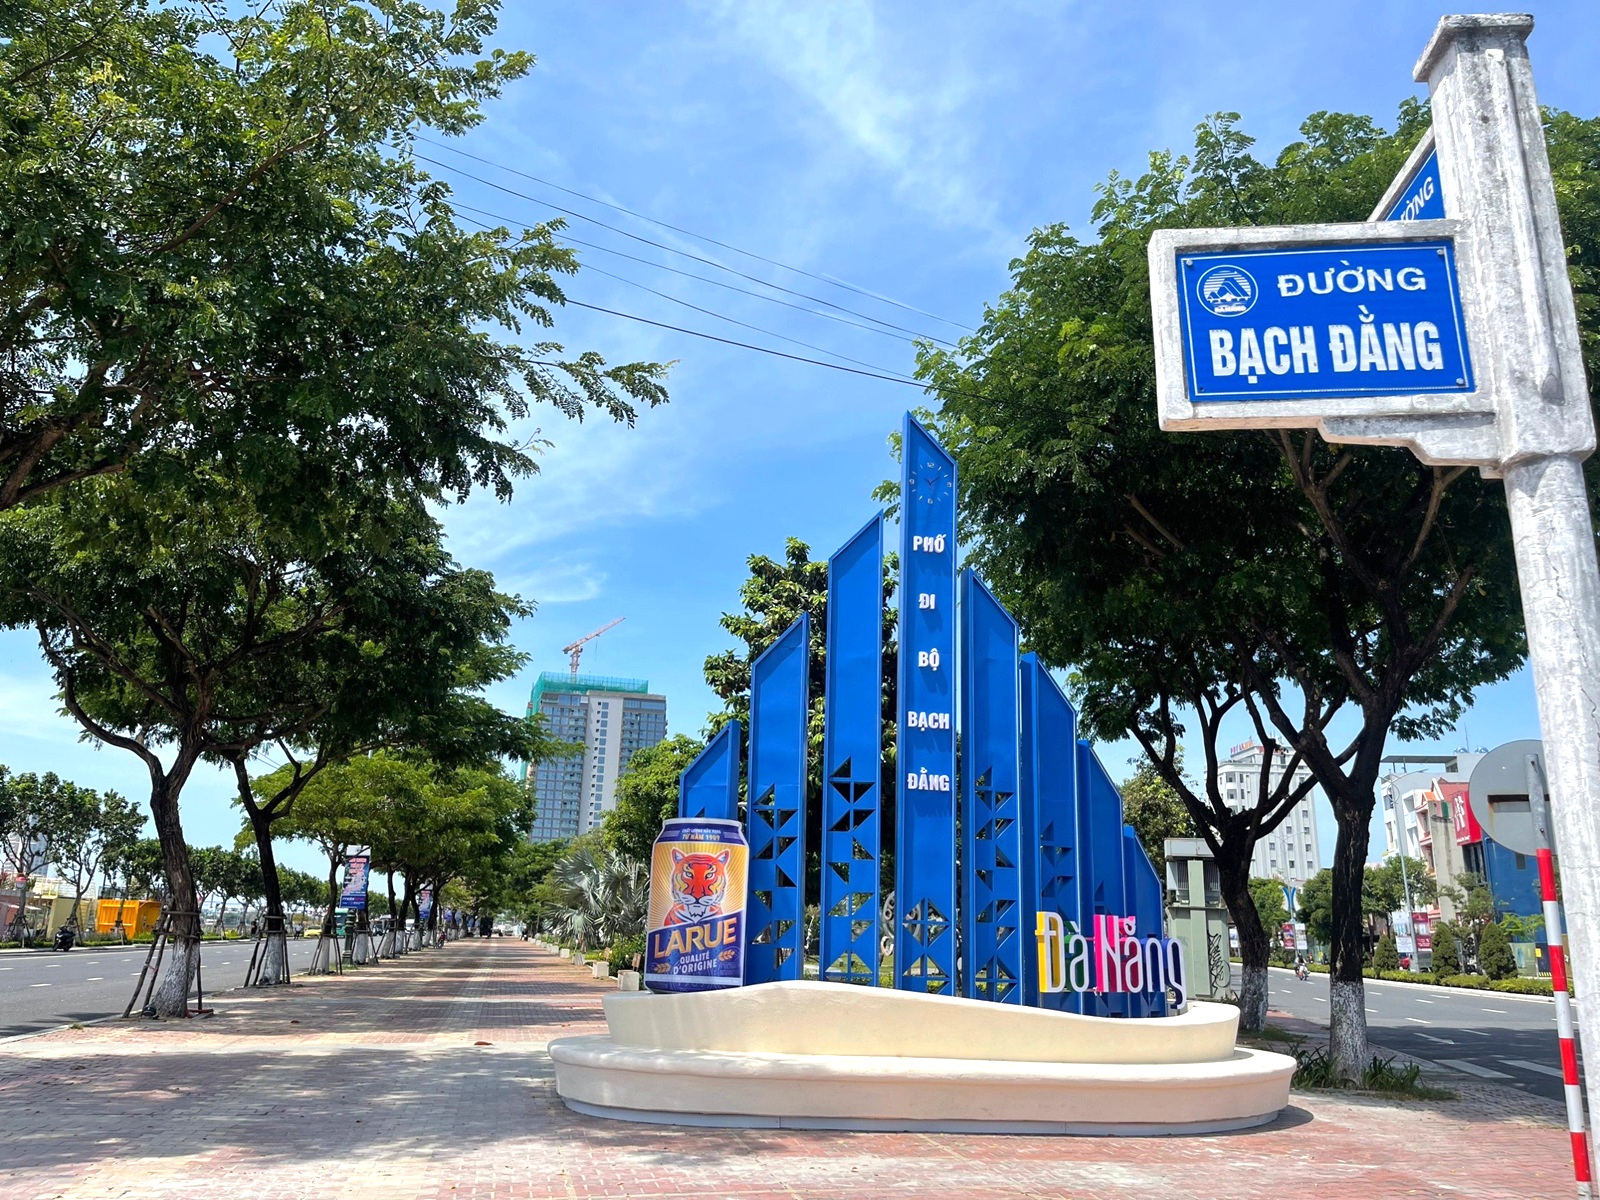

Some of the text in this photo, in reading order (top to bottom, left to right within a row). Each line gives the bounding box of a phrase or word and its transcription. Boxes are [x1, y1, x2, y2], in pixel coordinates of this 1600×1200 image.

[1277, 260, 1427, 297] ĐƯỜNG
[1208, 304, 1444, 384] BẠCH ĐẰNG
[912, 534, 947, 554] PHỐ
[918, 592, 936, 610] ĐI
[917, 647, 940, 671] BỘ
[907, 710, 950, 731] BẠCH
[907, 766, 950, 791] ĐẰNG
[654, 917, 737, 958] LARUE
[680, 950, 710, 965] QUALITÉ
[1035, 911, 1089, 993] Đà
[673, 958, 717, 975] D'ORIGINE
